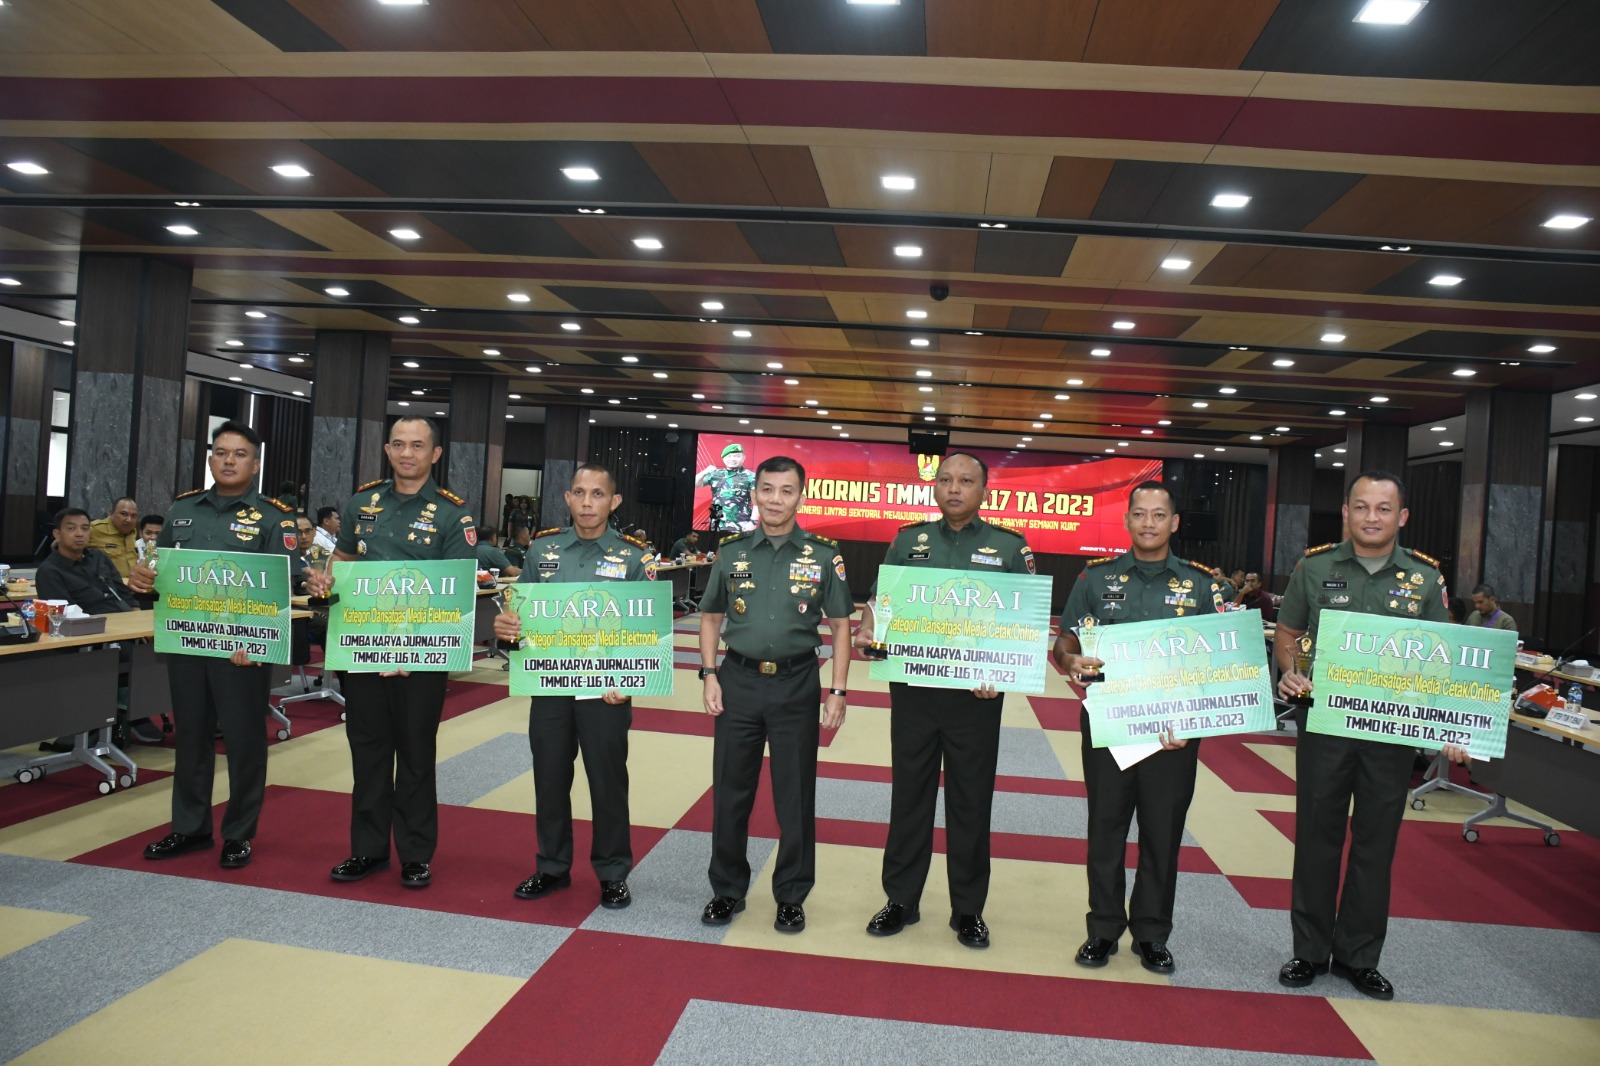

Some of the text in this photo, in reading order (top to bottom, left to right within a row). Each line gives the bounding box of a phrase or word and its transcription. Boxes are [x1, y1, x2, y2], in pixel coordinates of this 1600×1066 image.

[1016, 491, 1038, 512] TA
[1043, 493, 1094, 516] 2023
[177, 566, 268, 589] JUARA I
[352, 577, 456, 596] JUARA II
[167, 594, 278, 617] Kategori Dansatgas Media Elektronik
[907, 584, 1022, 610] JUARA I
[344, 607, 461, 626] Kategori Dansatgas Media Elektronik
[529, 598, 655, 618] JUARA III
[166, 620, 279, 640] LOMBA KARYA JURNALISTIK
[921, 616, 961, 640] Dansatgas
[963, 619, 987, 637] Media
[181, 637, 205, 648] TMMD
[207, 639, 233, 651] KE-116
[247, 642, 266, 655] 2023
[341, 635, 460, 647] LOMBA KARYA JURNALISTIK
[526, 630, 658, 650] Kategori Dansatgas Media Elektronik
[1110, 630, 1240, 663] JUARA II
[353, 652, 379, 663] TMMD
[380, 652, 408, 663] KE-116
[424, 652, 447, 664] 2023
[888, 644, 1033, 666] LOMBA KARYA JURNALISTIK
[1339, 631, 1494, 670] JUARA III
[524, 659, 660, 671] LOMBA KARYA JURNALISTIK
[904, 662, 935, 676] TMMD
[937, 665, 970, 679] KE-116
[540, 676, 645, 687] TMMD KE-116 TA. 2023
[1179, 667, 1205, 686] Media
[1327, 663, 1364, 688] Kategori
[1365, 668, 1411, 696] Dansatgas
[1414, 674, 1441, 694] Media
[1106, 693, 1259, 719] LOMBA KARYA JURNALISTIK
[1328, 694, 1492, 730] LOMBA KARYA JURNALISTIK
[1127, 721, 1160, 736] TMMD
[1346, 716, 1380, 732] TMMD
[1382, 721, 1420, 738] KE-116
